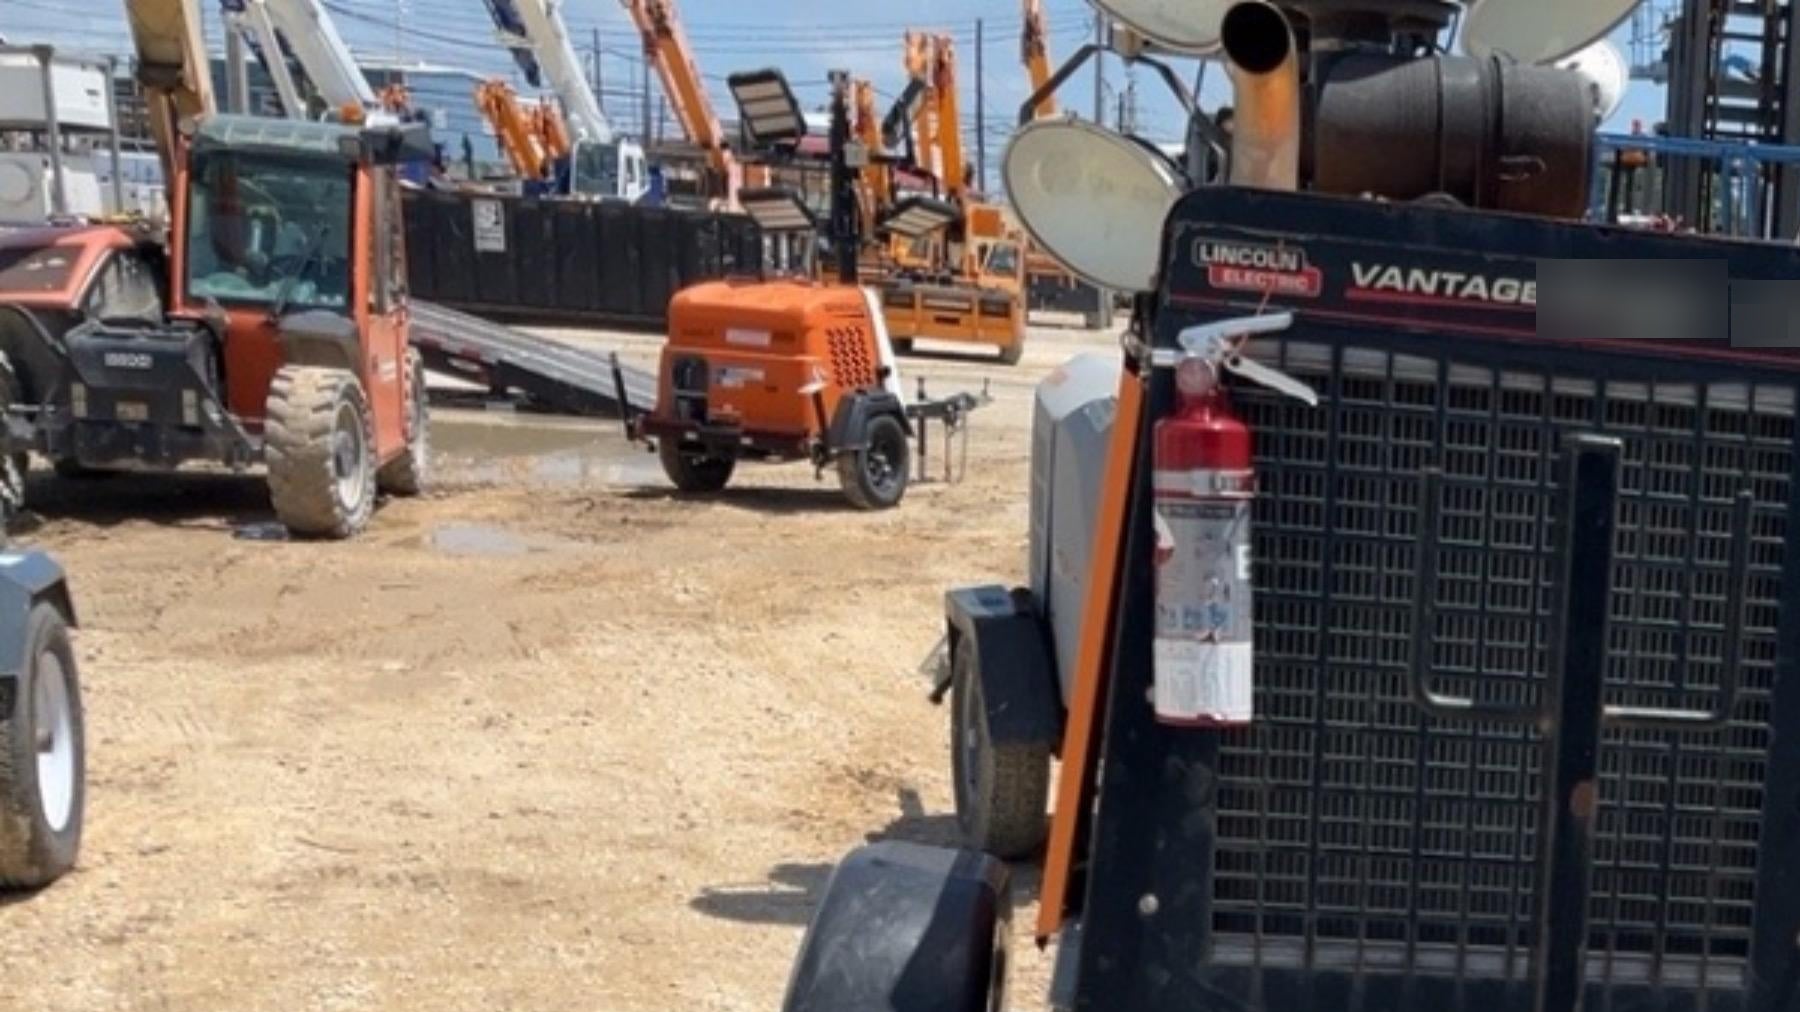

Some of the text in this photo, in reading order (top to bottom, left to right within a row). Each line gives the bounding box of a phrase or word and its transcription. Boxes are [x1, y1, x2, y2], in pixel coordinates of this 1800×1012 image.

[1200, 244, 1298, 271] LINCOLN
[1223, 268, 1309, 291] ELECTRIC
[1351, 262, 1536, 305] VANTAGE
